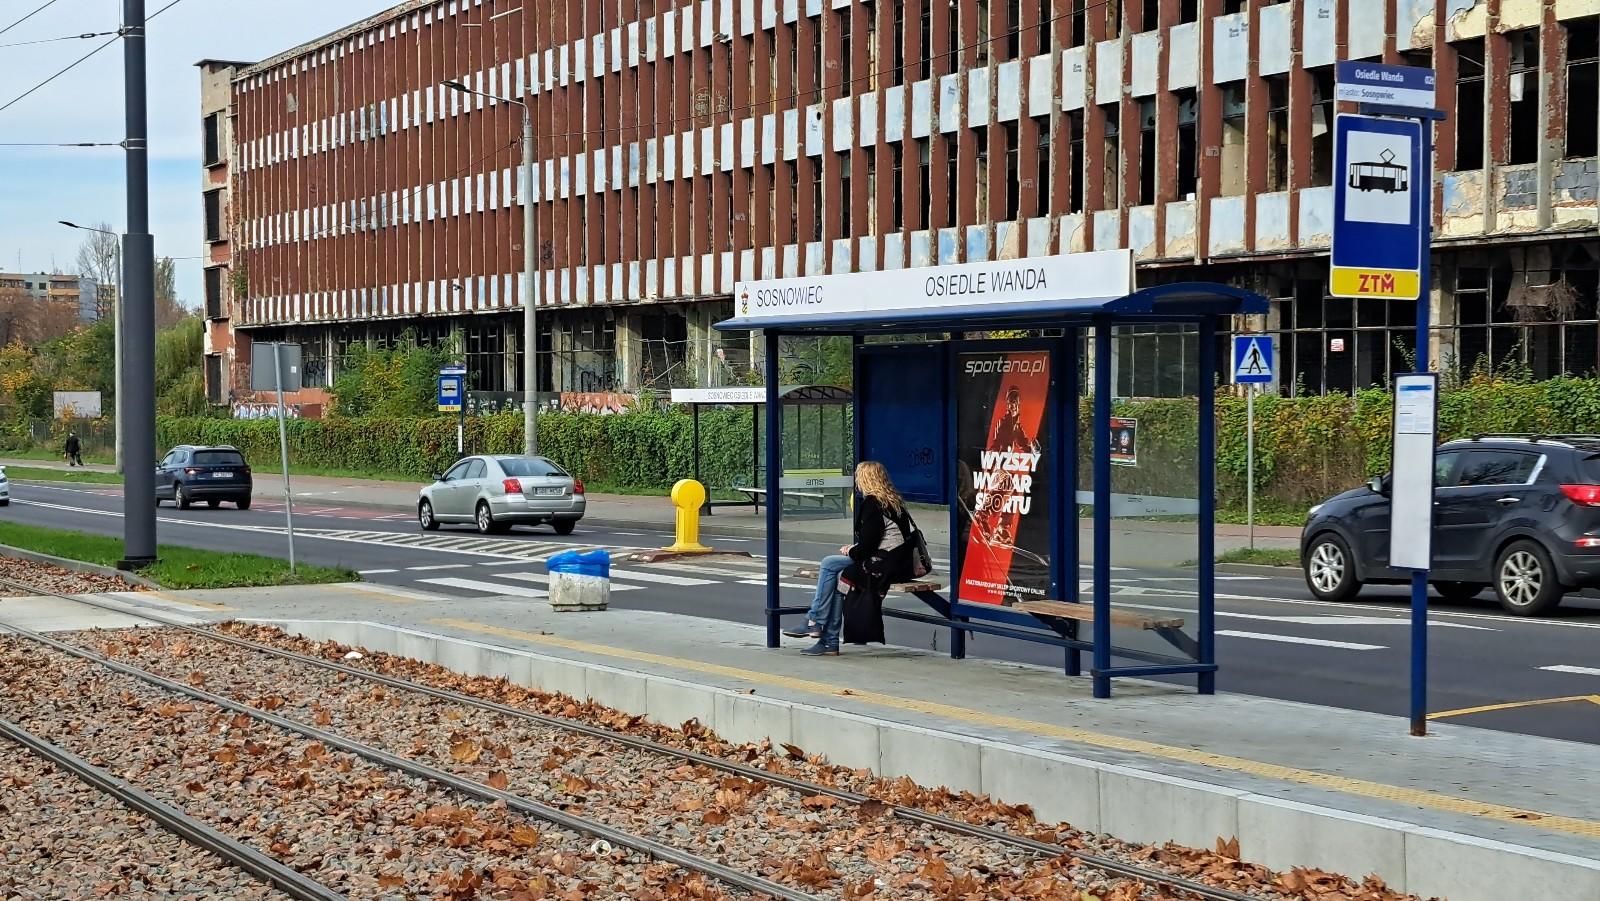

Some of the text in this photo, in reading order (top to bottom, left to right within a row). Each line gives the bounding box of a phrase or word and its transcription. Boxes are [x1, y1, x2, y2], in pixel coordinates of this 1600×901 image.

[1355, 69, 1380, 80] Osiedle
[1381, 71, 1404, 82] Wanda
[925, 268, 1047, 297] OSIEDLE WANDA
[1358, 273, 1394, 293] ZTM
[756, 285, 823, 307] SOSNOWIEC
[965, 356, 1047, 377] sportano.pl
[980, 446, 1041, 471] WYŻSZY
[806, 477, 824, 486] ams
[975, 492, 1031, 515] SPORTU
